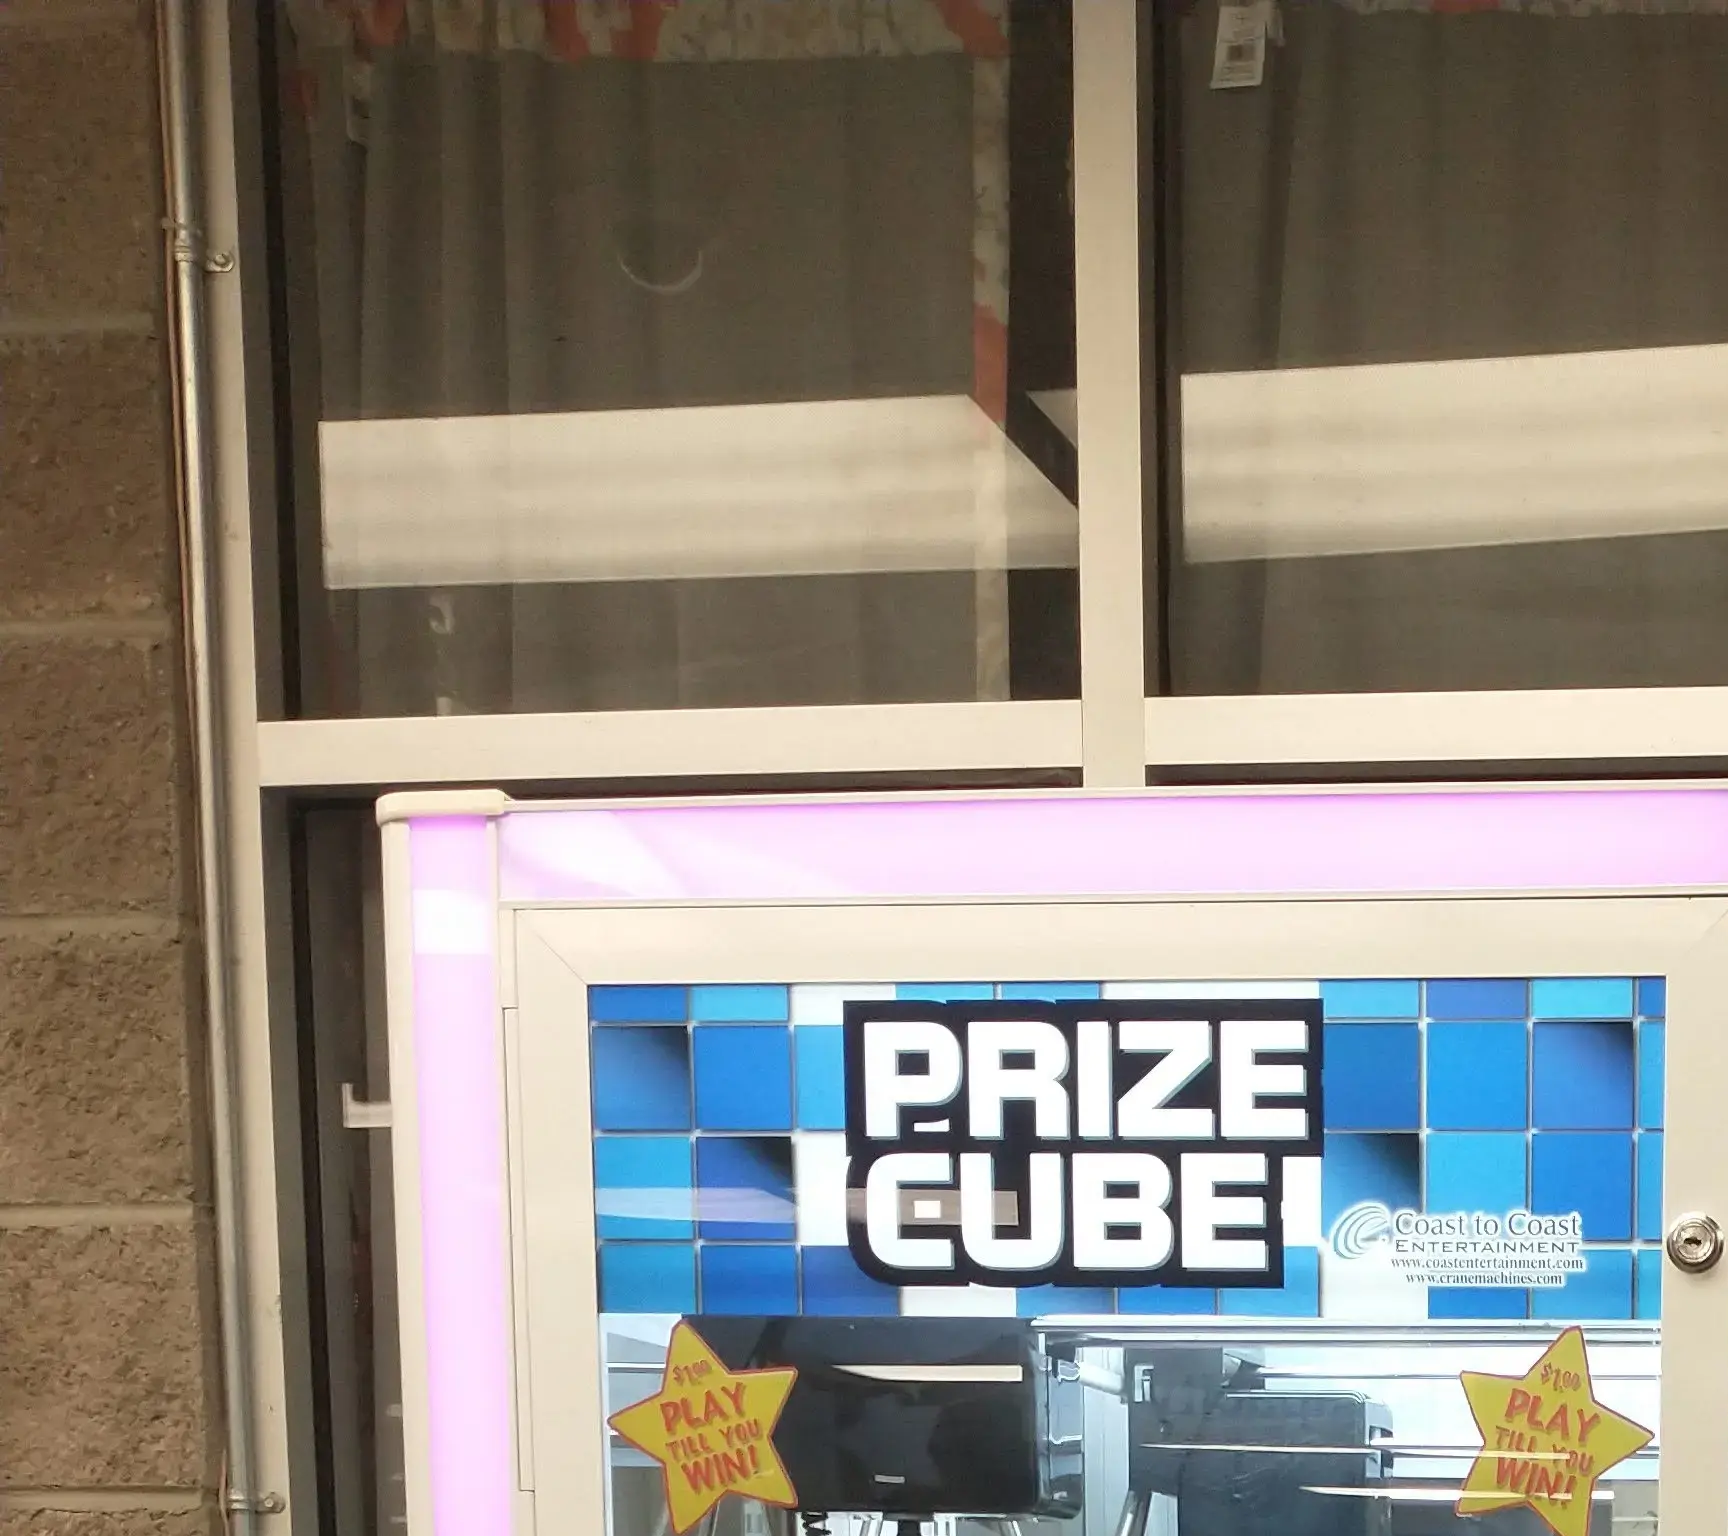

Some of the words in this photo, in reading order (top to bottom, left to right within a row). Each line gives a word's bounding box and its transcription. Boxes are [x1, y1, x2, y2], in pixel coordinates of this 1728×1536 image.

[863, 1020, 1309, 1141] PRIZE
[866, 1152, 1269, 1271] CUBE
[1395, 1212, 1465, 1236] Coast
[1475, 1215, 1498, 1236] to
[1508, 1212, 1580, 1236] Coast
[1391, 1256, 1585, 1270] www.coastentertainment.com
[1395, 1240, 1580, 1253] ENTERTAINMENT
[1406, 1271, 1563, 1285] www.cranemachines.com
[1540, 1362, 1582, 1393] $1.00
[660, 1381, 747, 1434] PLAY
[1504, 1387, 1601, 1446] PLAY
[665, 1433, 712, 1463] TILL
[718, 1418, 762, 1448] YOU
[1495, 1425, 1537, 1455] TILL
[1552, 1443, 1594, 1476] YOU
[680, 1444, 760, 1496] WIN!
[1495, 1457, 1578, 1510] WIN!
